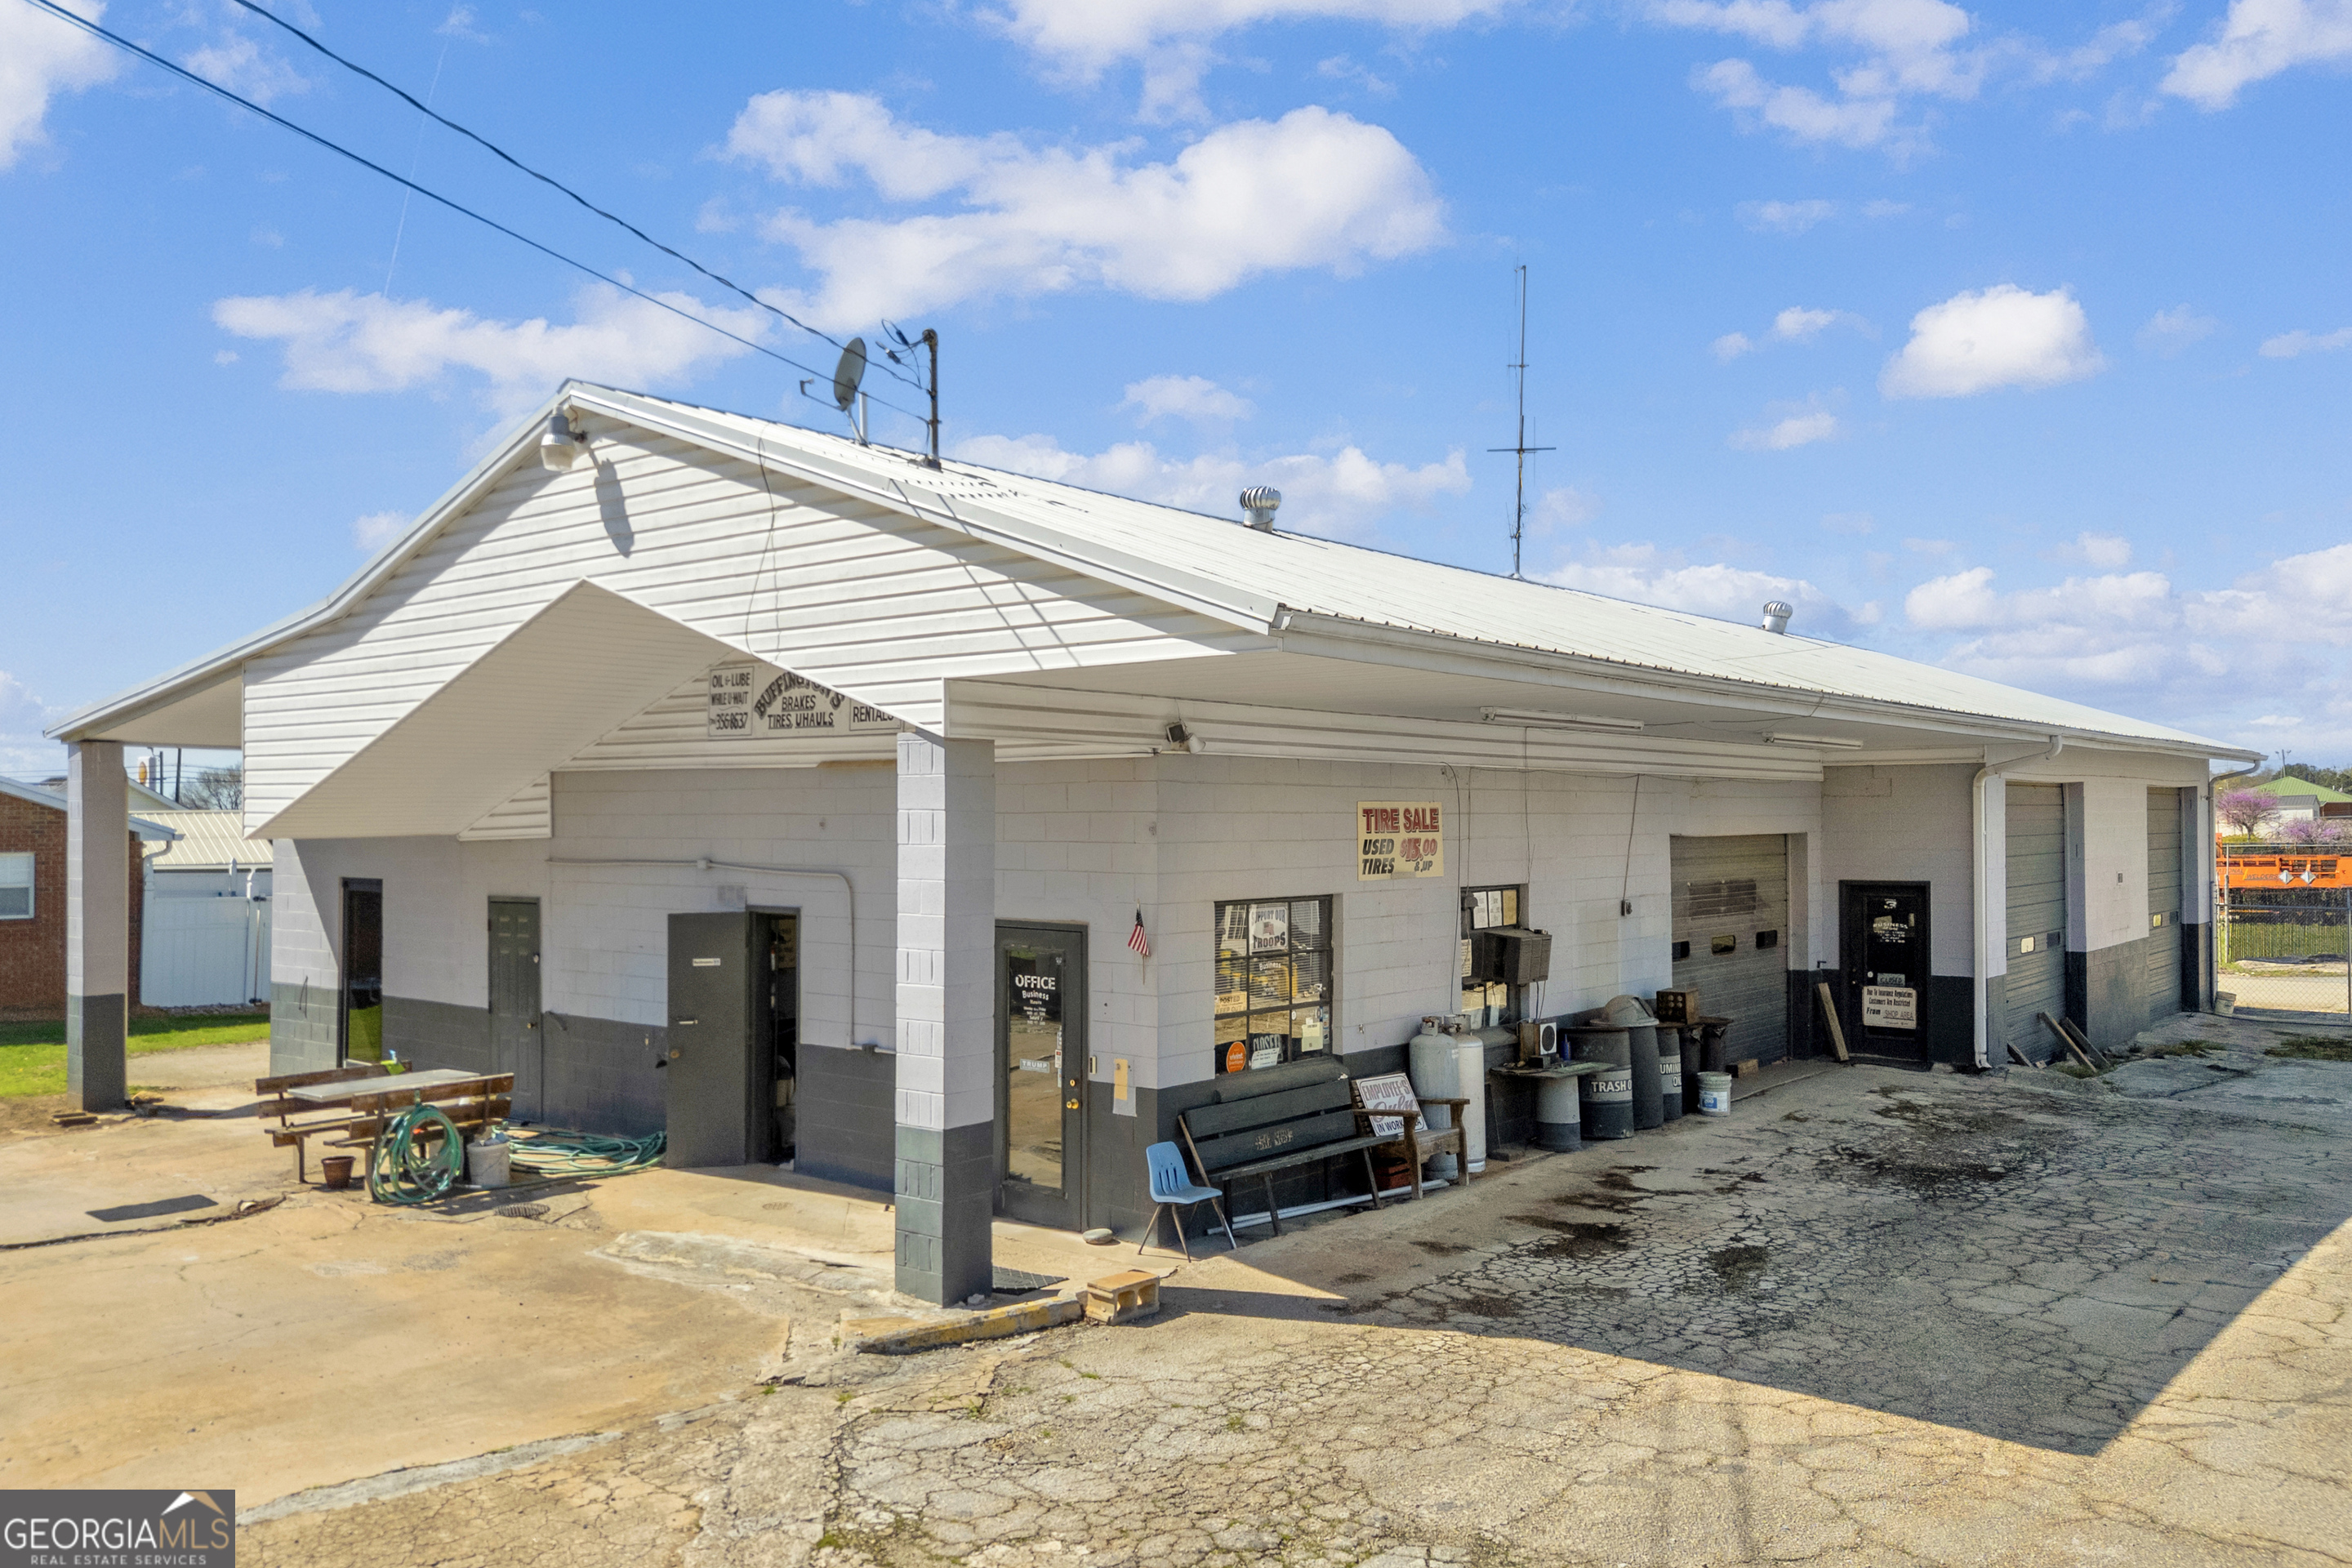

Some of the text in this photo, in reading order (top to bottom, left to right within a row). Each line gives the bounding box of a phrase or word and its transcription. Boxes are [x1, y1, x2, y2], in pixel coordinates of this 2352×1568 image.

[712, 675, 724, 688] OIL
[731, 672, 751, 687] LUBE
[711, 693, 727, 706] WHILE
[782, 695, 817, 710] BRAKES
[795, 712, 835, 728] UHAULS
[1362, 807, 1439, 834] TIRE SALE
[1362, 838, 1395, 856] USED
[1361, 858, 1396, 875] TIRES
[1414, 860, 1433, 872] & UP
[1275, 909, 1286, 924] OUR
[1252, 931, 1286, 949] TROOPS
[1014, 974, 1056, 991] OFFICE
[1022, 990, 1049, 1001] Business
[1219, 996, 1241, 1004] POSTED
[1894, 990, 1913, 999] Regulations
[1869, 997, 1886, 1005] Customers
[1893, 999, 1911, 1007] Restricted
[1866, 1007, 1913, 1019] From SHOP AREA
[1022, 1060, 1048, 1068] TRUMP
[1361, 1080, 1410, 1102] EMPLOYEE'S
[1591, 1080, 1626, 1092] TRASH
[1376, 1123, 1385, 1133] IN
[1385, 1120, 1404, 1131] WORK
